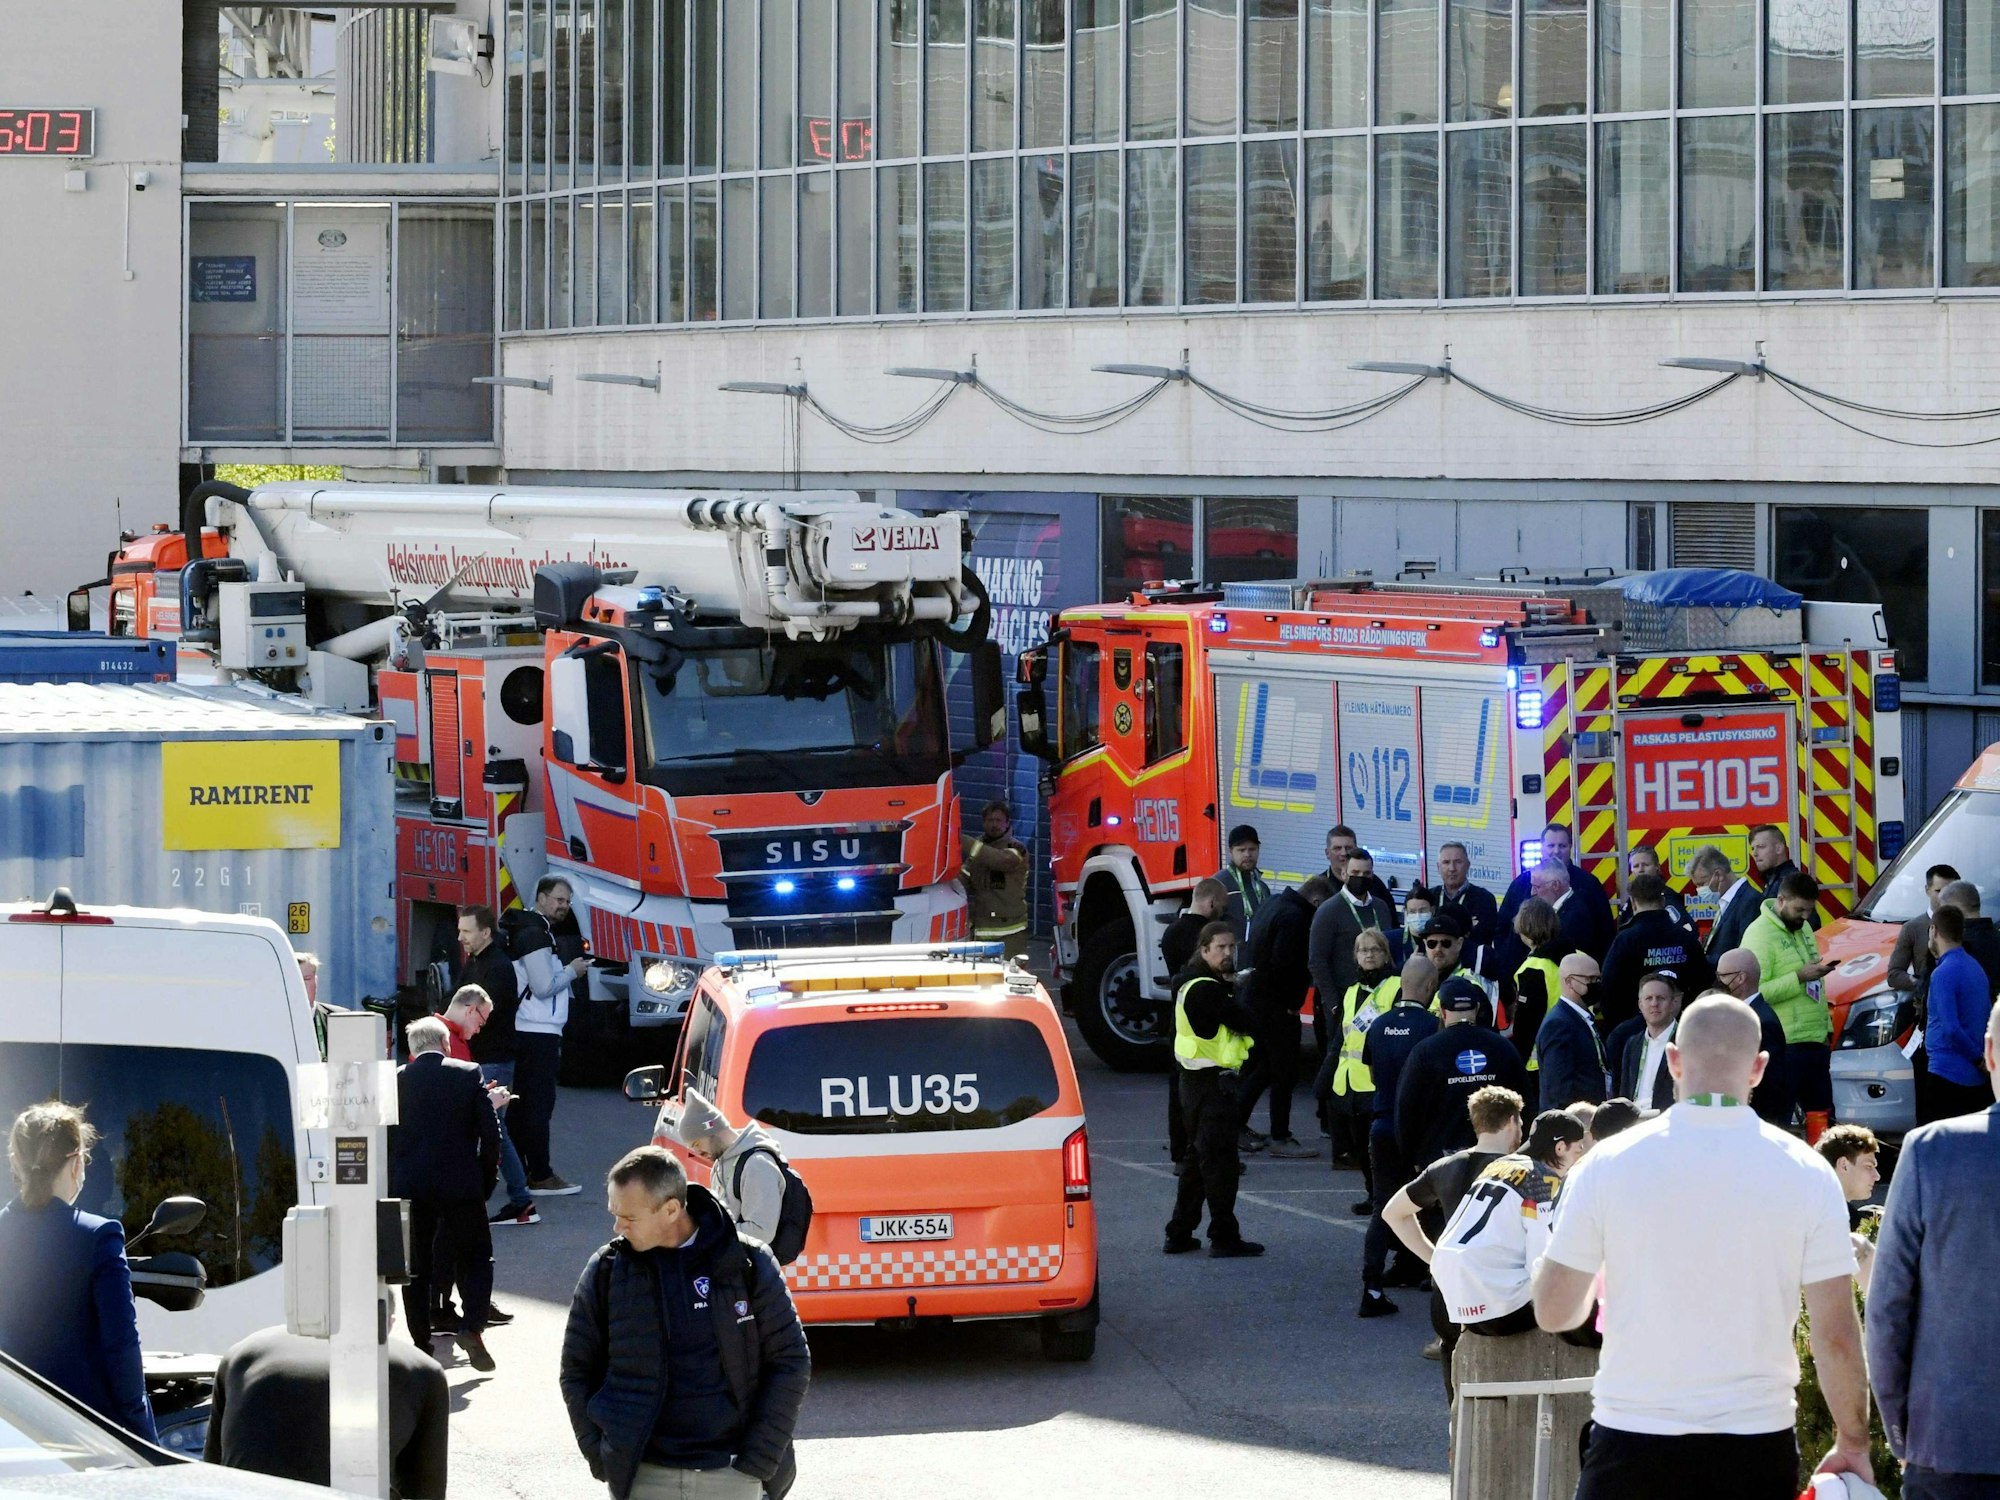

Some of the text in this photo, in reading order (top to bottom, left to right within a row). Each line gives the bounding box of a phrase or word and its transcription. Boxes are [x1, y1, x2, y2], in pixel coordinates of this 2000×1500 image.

[877, 526, 940, 550] VEMA
[387, 543, 451, 591] Helsingin
[451, 545, 530, 598] kaupungin
[976, 557, 1044, 607] MAKING
[986, 607, 1049, 655] RACLES
[1280, 624, 1427, 647] HELSINGFORS STADS RÄDDNINGSVERK
[1344, 701, 1412, 717] YLEINEN HÄTÄNUMERO
[1633, 726, 1777, 745] RASKAS PELASTUSYKSIKKÖ
[189, 784, 313, 806] RAMIRENT
[1372, 746, 1411, 822] 112
[1634, 756, 1780, 813] HE105
[1135, 799, 1180, 842] HE105
[414, 829, 456, 874] HE106
[766, 838, 860, 864] SISU
[1643, 955, 1688, 967] MIRACLES
[1647, 946, 1683, 958] MAKING
[1384, 1026, 1411, 1036] Reboot
[1447, 1075, 1488, 1085] EXPOELEKTRO
[820, 1073, 980, 1118] RLU35
